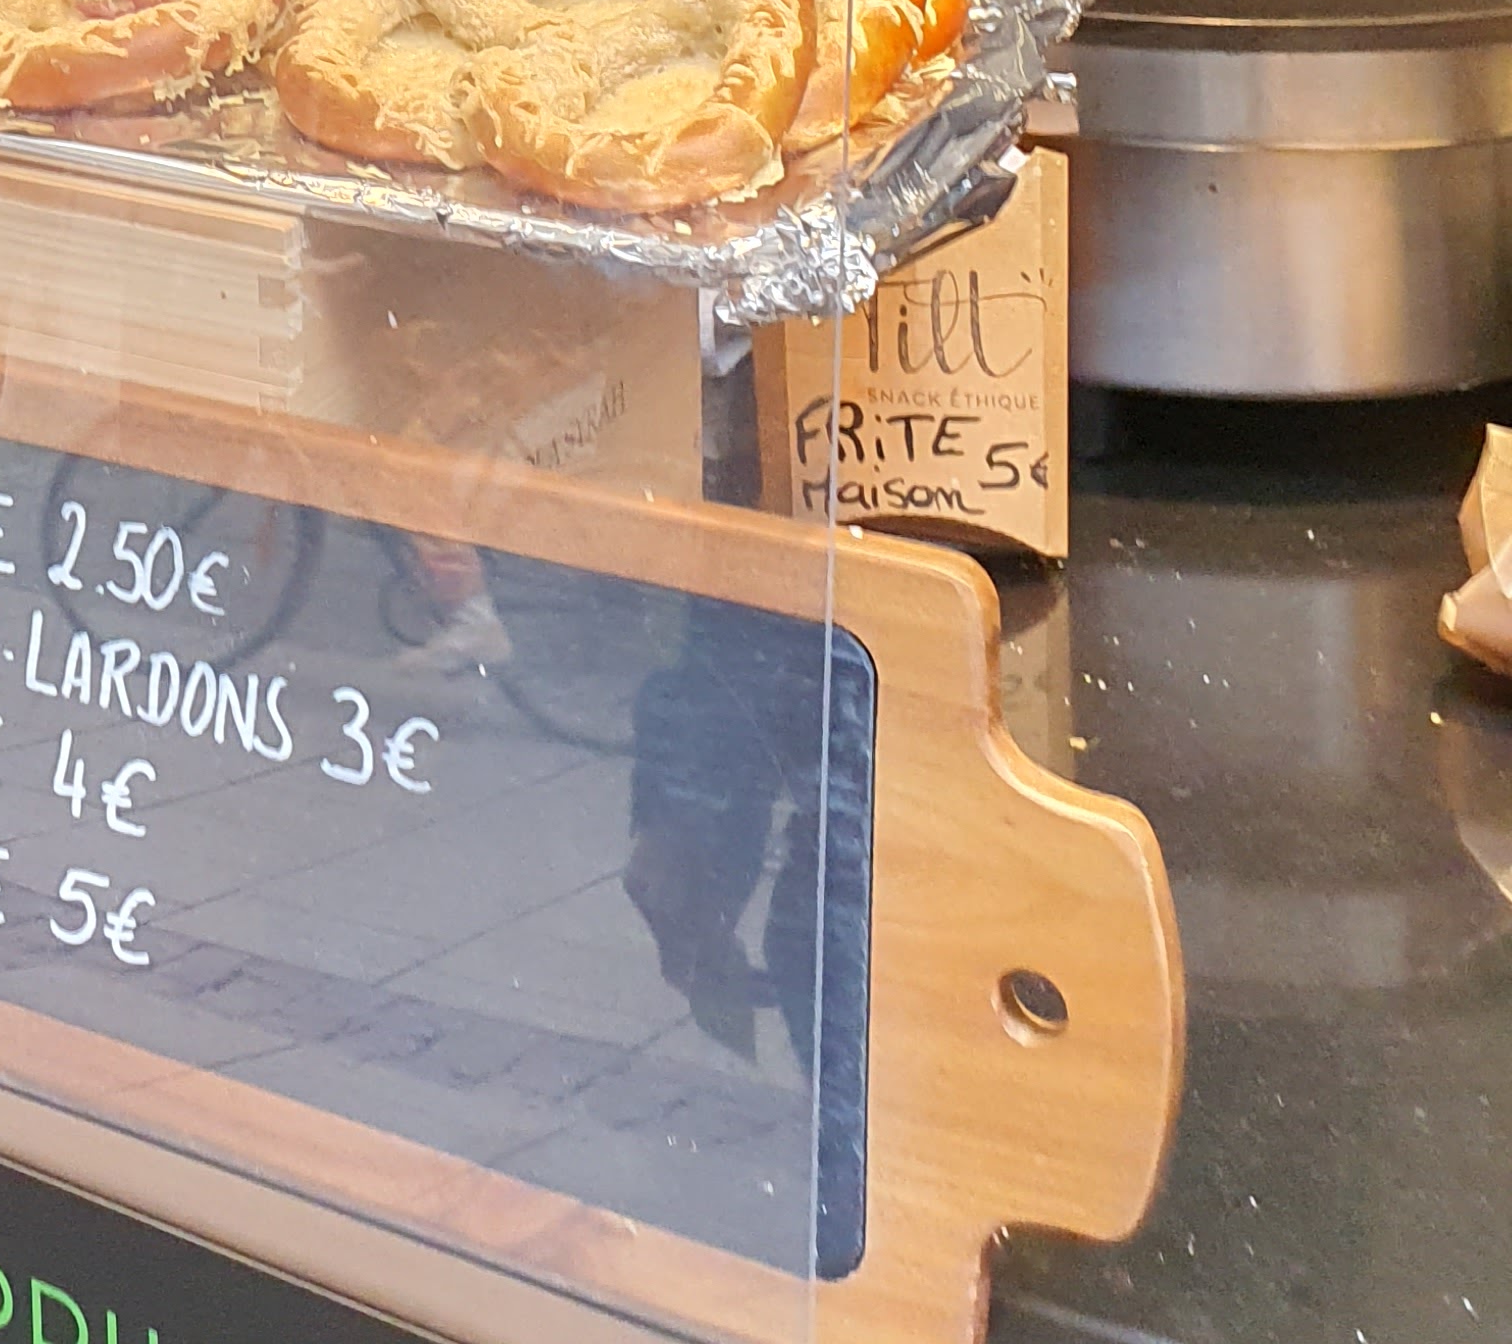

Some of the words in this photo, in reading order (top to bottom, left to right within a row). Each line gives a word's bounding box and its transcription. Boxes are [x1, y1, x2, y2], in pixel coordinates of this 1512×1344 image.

[862, 268, 1048, 378] Tilt
[867, 387, 941, 408] SNACK
[949, 386, 1041, 411] ÉTHIQUE
[53, 728, 156, 836] 4€
[320, 686, 439, 793] 3€
[49, 867, 155, 965] 5€
